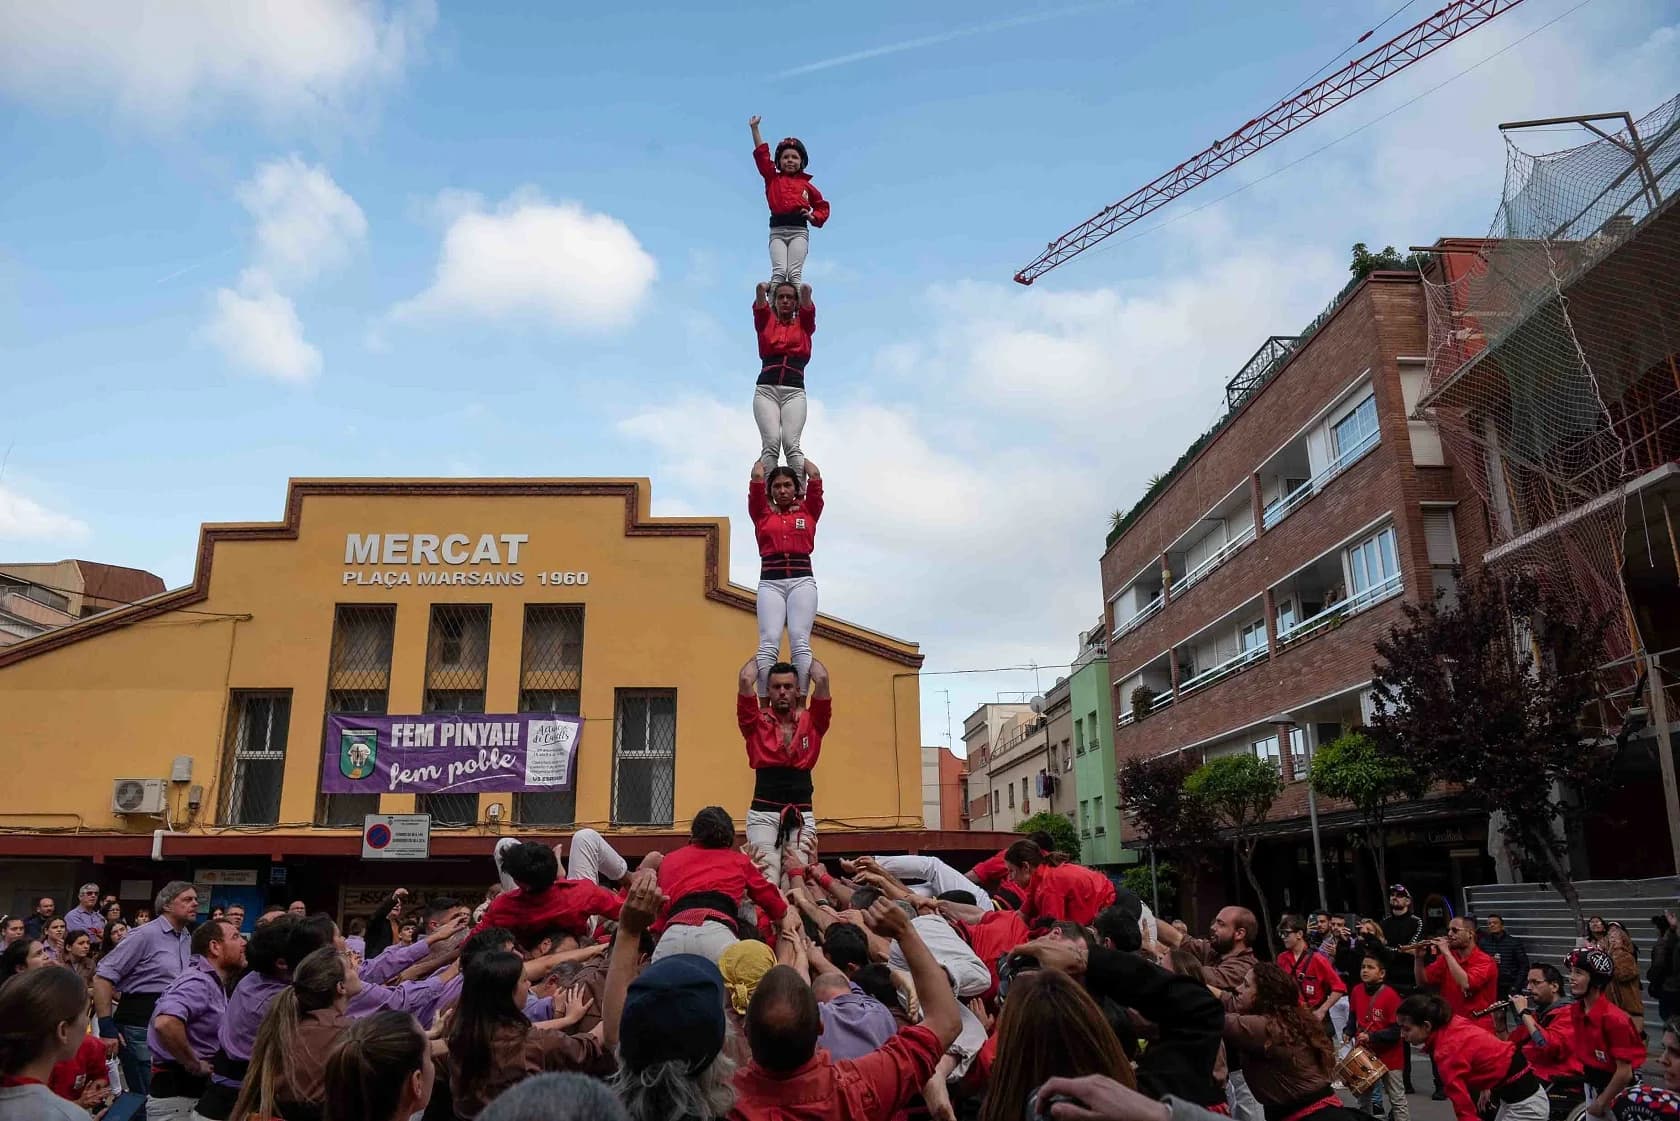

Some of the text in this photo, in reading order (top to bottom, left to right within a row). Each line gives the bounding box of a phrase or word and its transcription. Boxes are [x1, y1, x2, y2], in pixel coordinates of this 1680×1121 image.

[344, 533, 529, 565] MERCAT
[343, 571, 589, 588] PLAÇA MARSANS 1960
[391, 722, 520, 747] FEM PINYA!!
[389, 763, 442, 791] fem
[448, 747, 517, 784] poble
